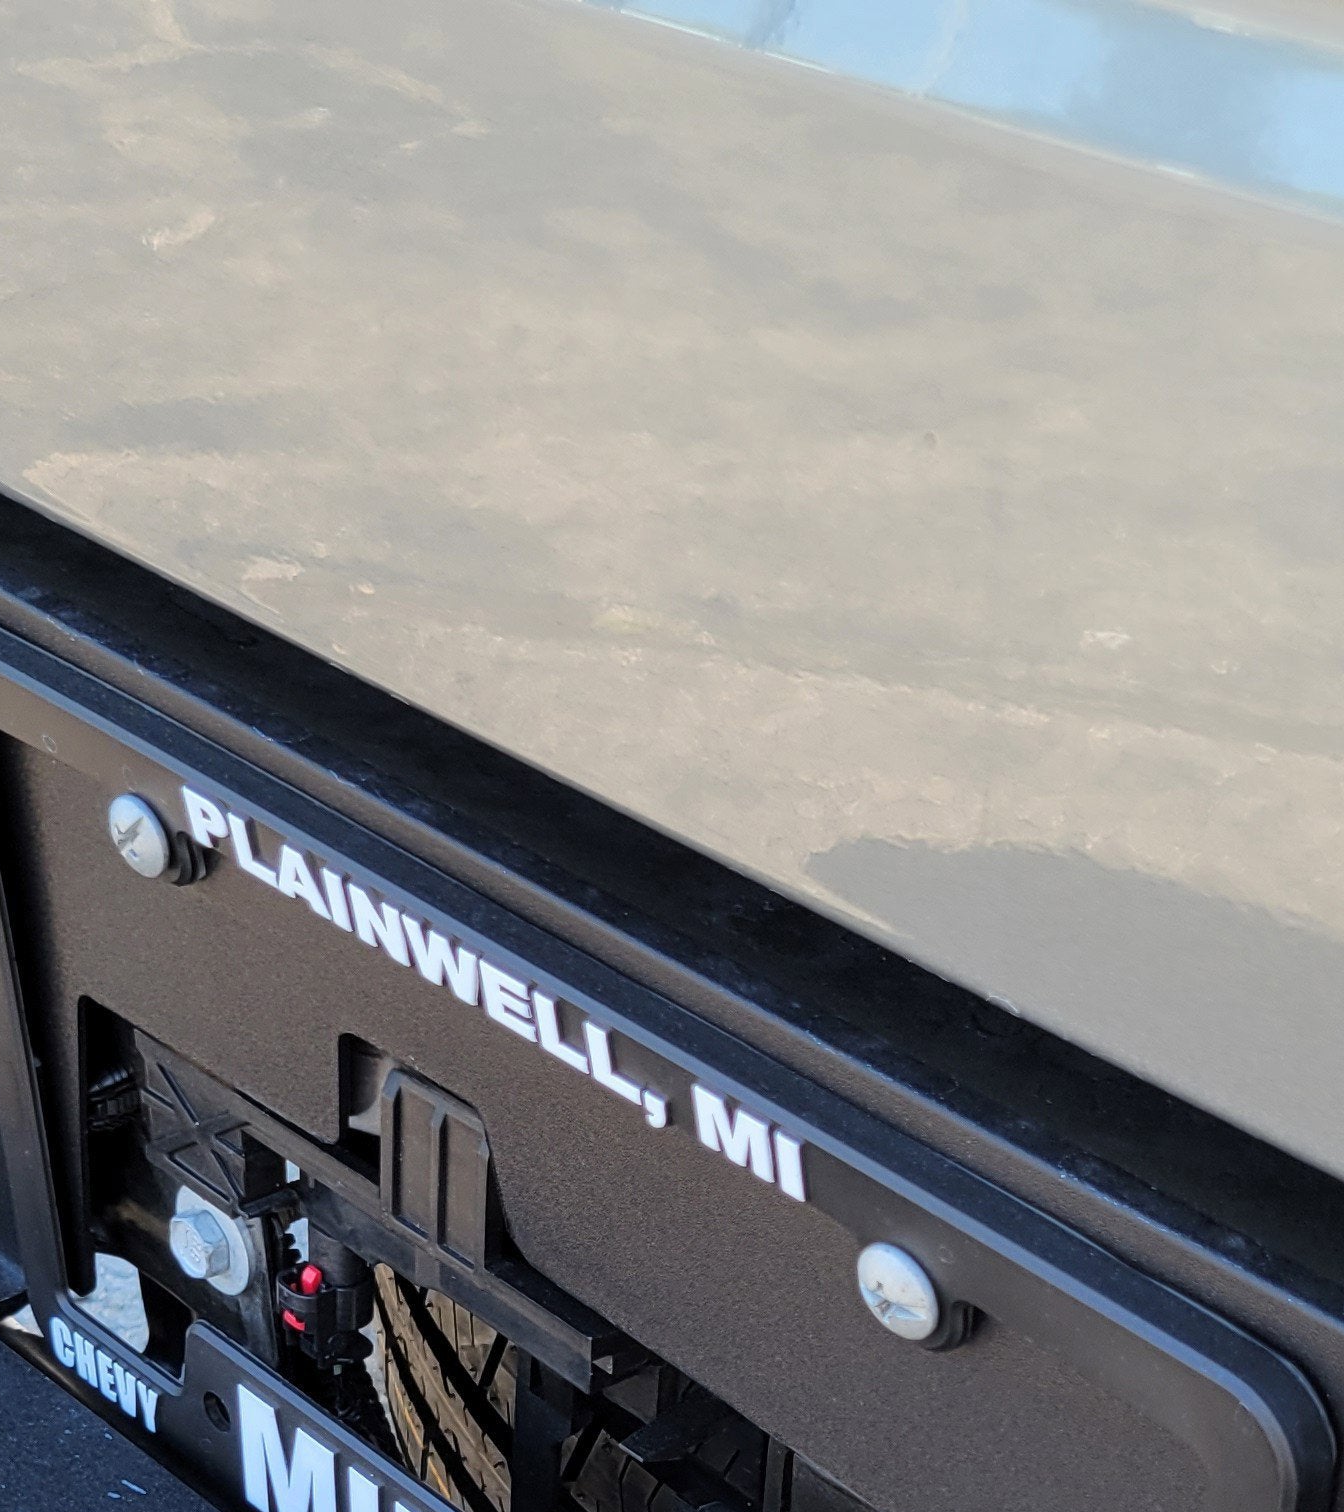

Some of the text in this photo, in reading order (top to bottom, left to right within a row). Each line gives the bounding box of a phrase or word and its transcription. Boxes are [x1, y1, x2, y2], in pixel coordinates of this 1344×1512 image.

[180, 784, 807, 1204] PLAINWELL, MI
[49, 1315, 160, 1434] CHEVY
